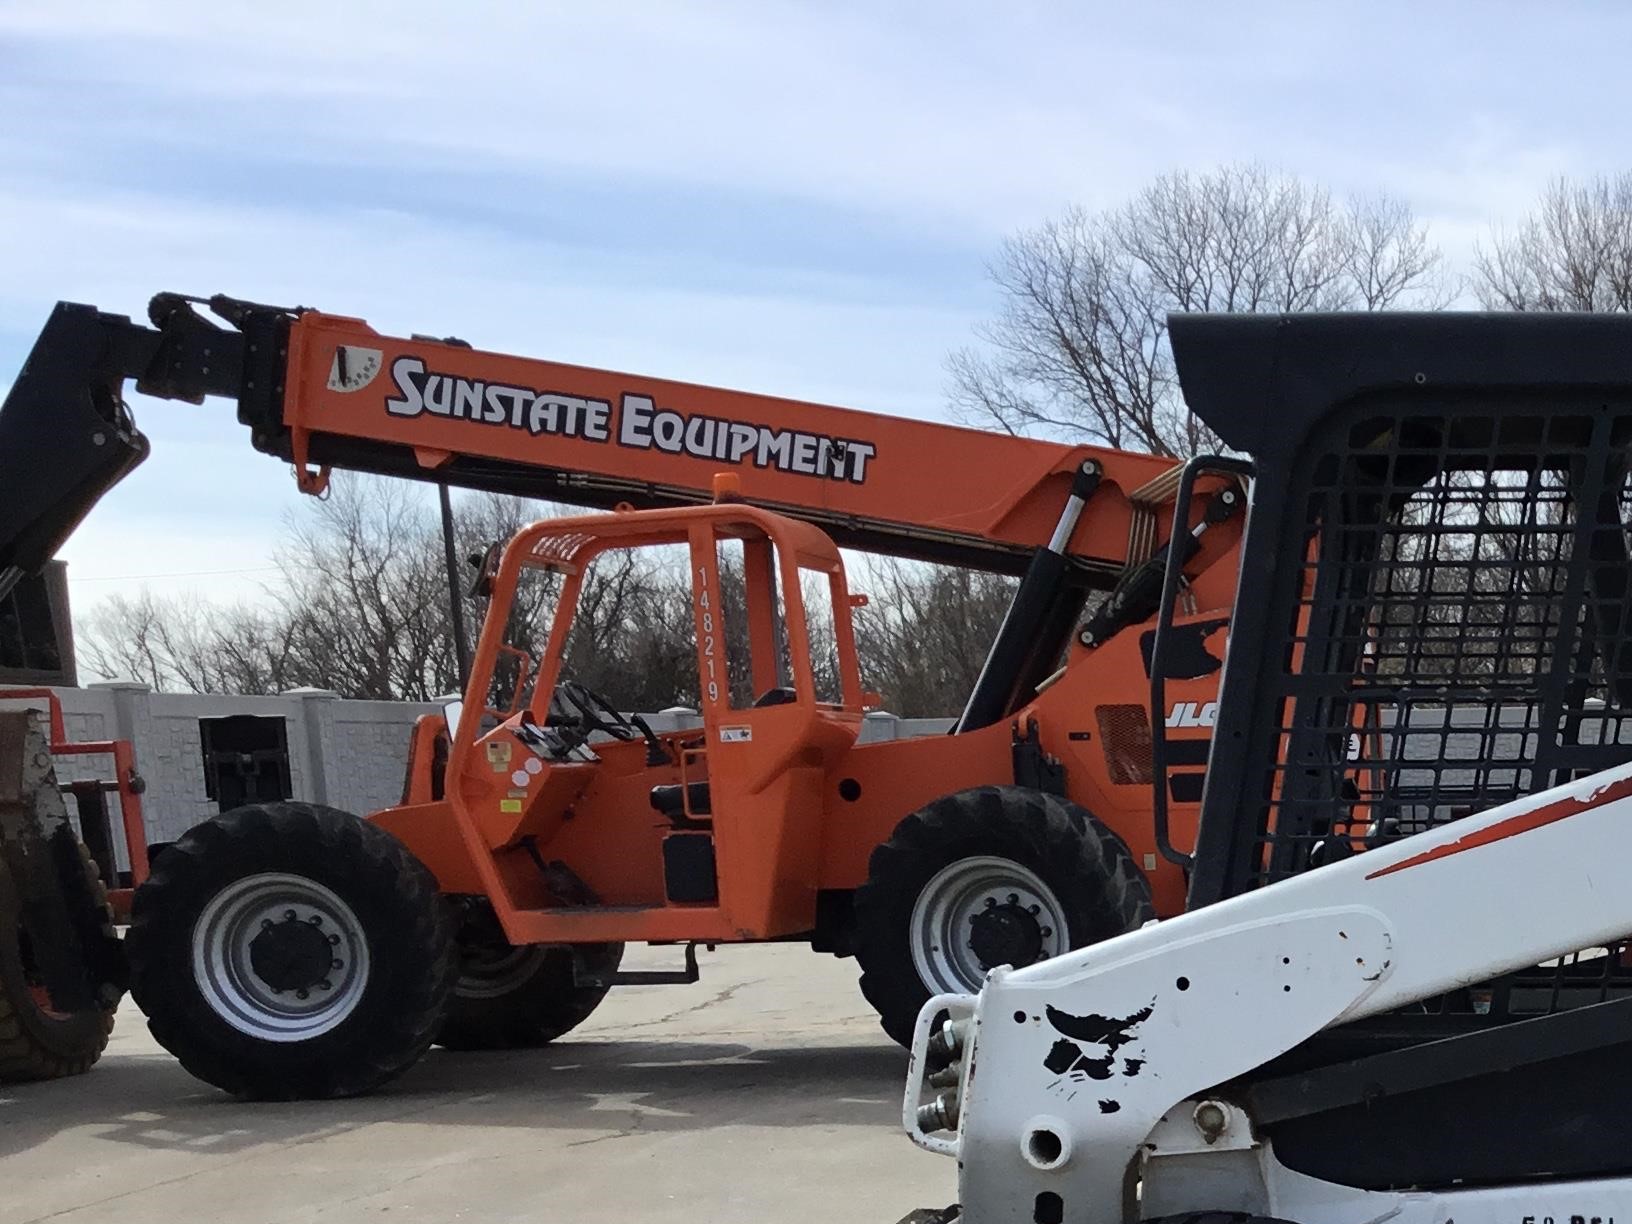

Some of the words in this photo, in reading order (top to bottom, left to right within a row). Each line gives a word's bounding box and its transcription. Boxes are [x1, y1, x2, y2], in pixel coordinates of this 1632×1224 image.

[386, 357, 611, 441] SUNSTATE
[619, 393, 876, 483] EQUIPMENT
[699, 567, 718, 701] 148219
